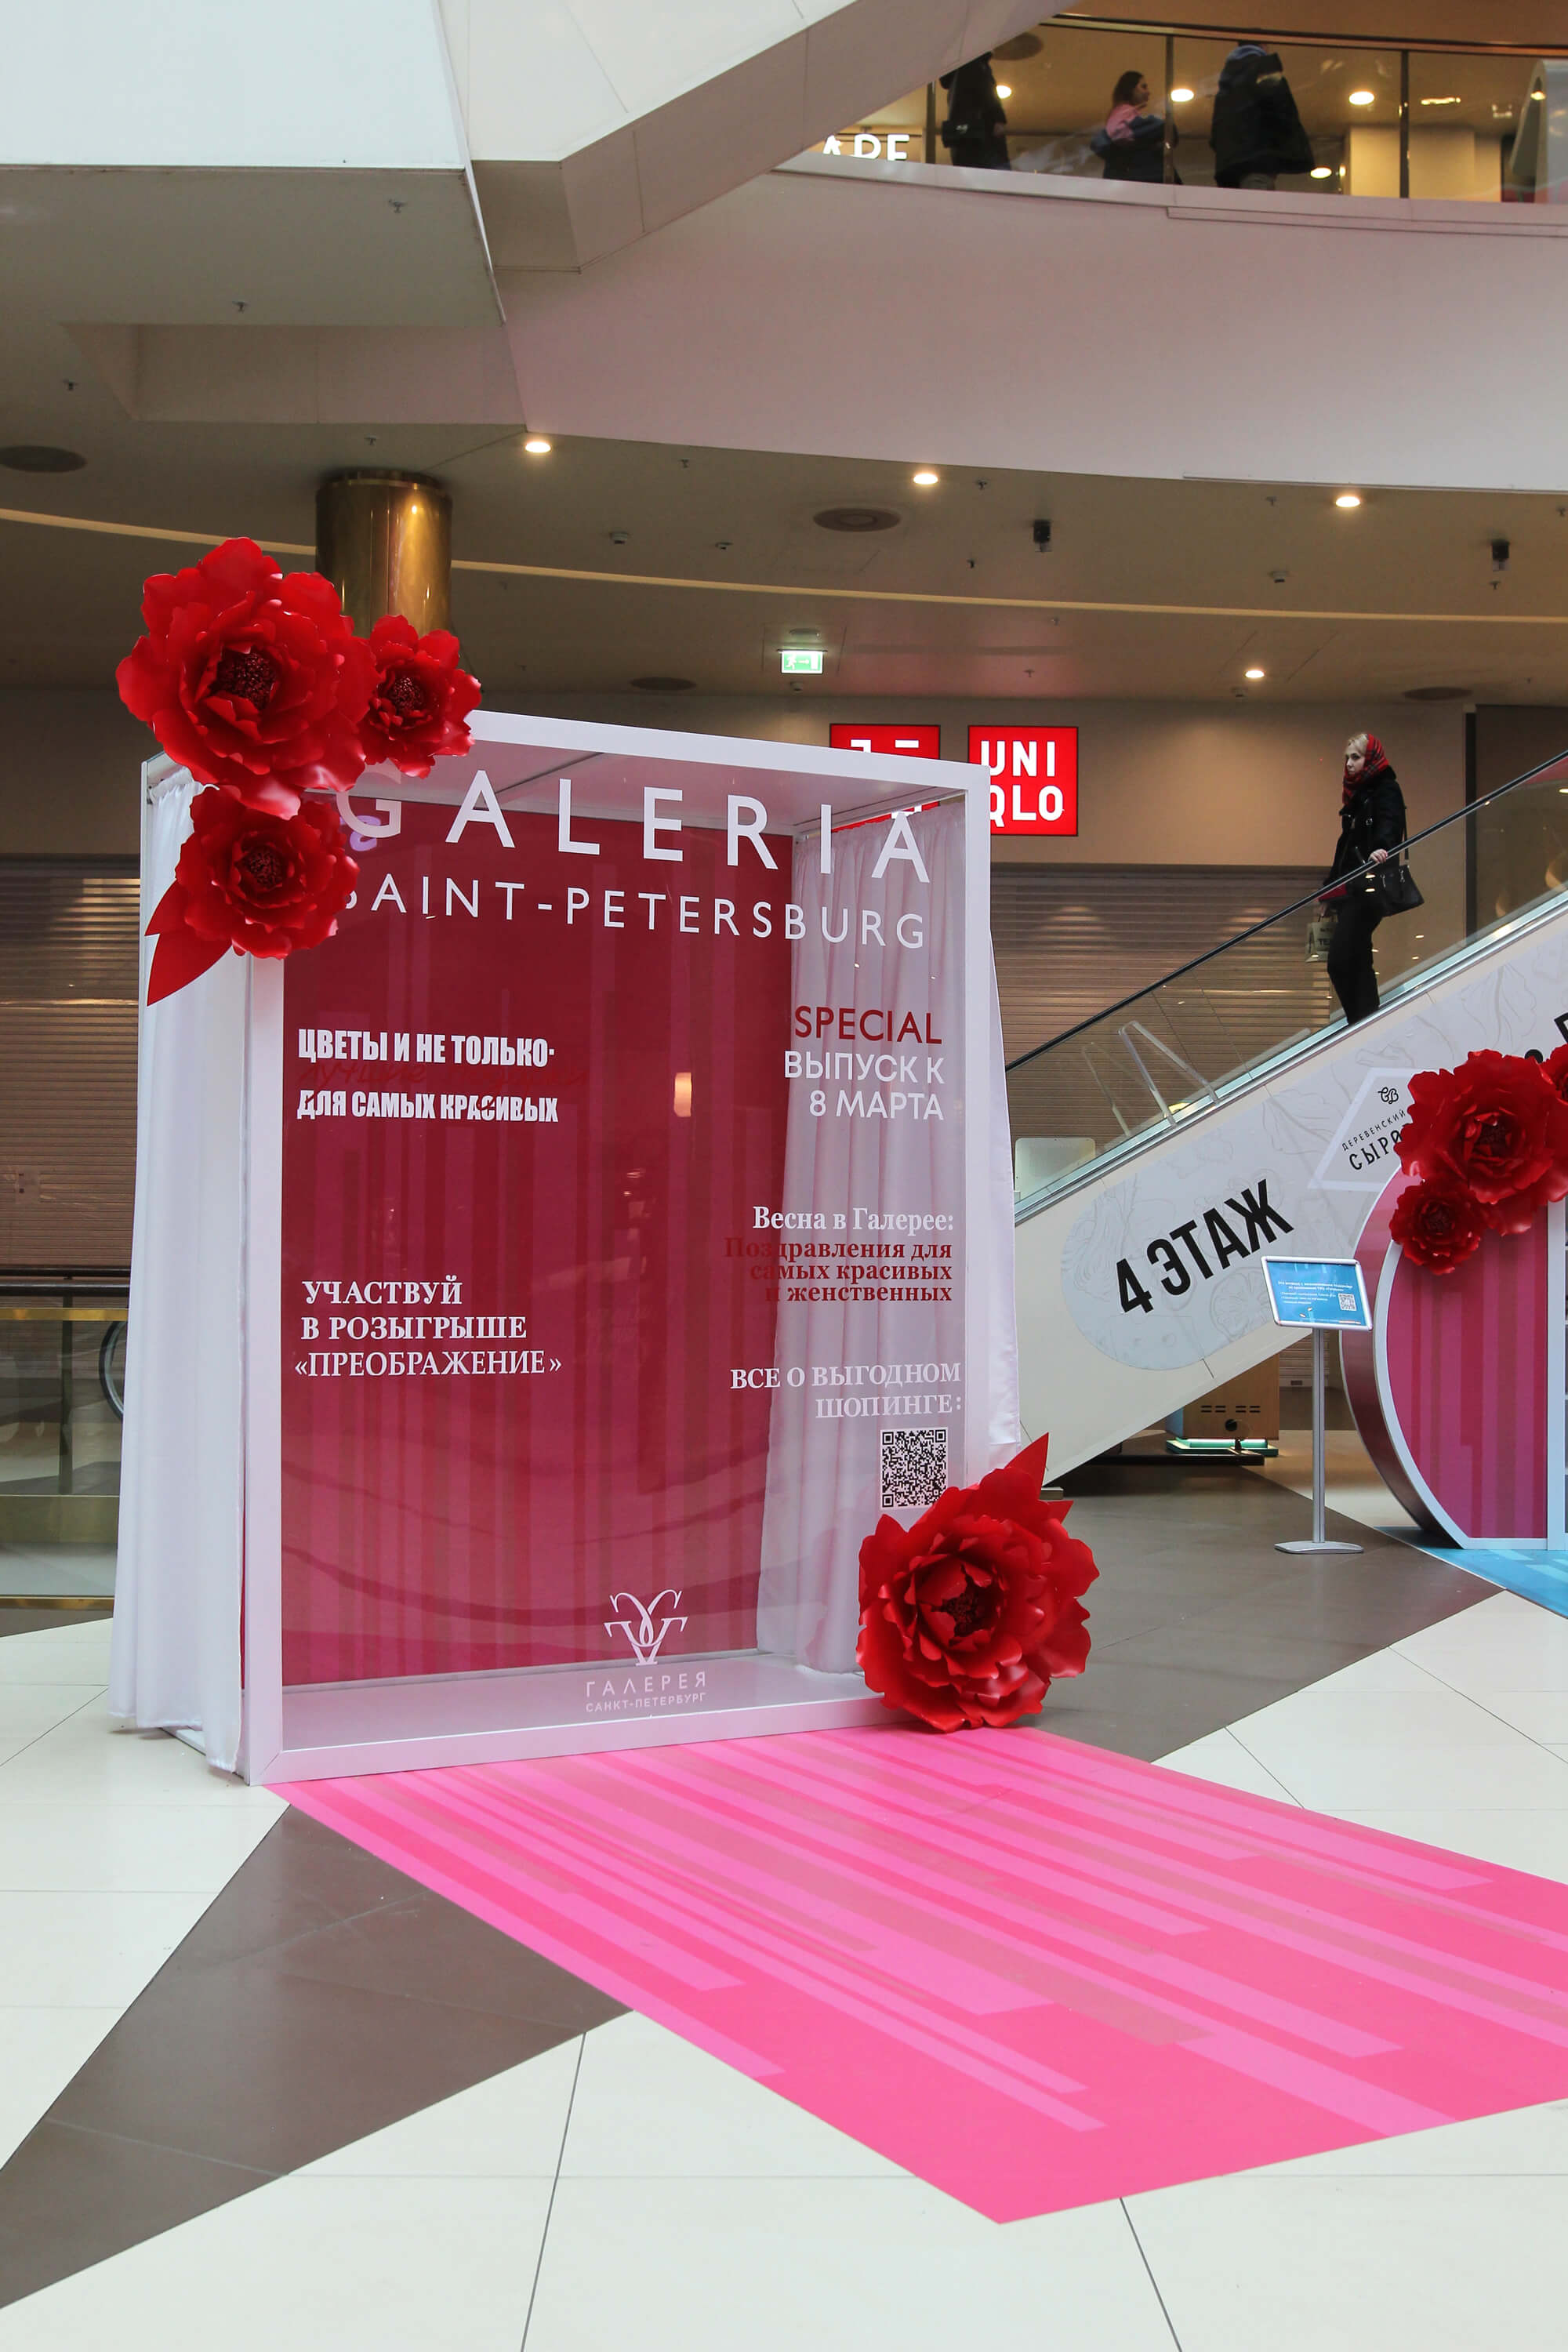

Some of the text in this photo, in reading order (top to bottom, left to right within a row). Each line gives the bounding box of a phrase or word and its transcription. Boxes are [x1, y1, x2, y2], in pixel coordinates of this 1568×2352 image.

[981, 740, 1055, 777] UNI
[336, 760, 930, 884] GALERIA
[345, 873, 924, 949] AINT-PETERSBURG
[794, 1005, 942, 1044] SPECIAL
[298, 1029, 387, 1063] ЦВЕТЫ
[394, 1033, 410, 1062] И
[416, 1033, 445, 1063] НЕ
[784, 1051, 945, 1084] ВЫПУСК К
[297, 1090, 559, 1123] ДЛЯ САМЫХ КРАСИВЫХ
[809, 1090, 945, 1120] 8 МАРТА
[1341, 1109, 1406, 1152] ДЕРЕВЕНСКИЙ
[753, 1206, 954, 1236] Весна в Галерее:
[724, 1237, 953, 1263] Поздравления для
[1116, 1179, 1295, 1315] 4 ЭТАЖ
[750, 1264, 953, 1285] самых красивых
[302, 1275, 463, 1305] УЧАСТВУЙ
[787, 1285, 953, 1301] женственных
[301, 1316, 527, 1340] В РОЗЫГРЫШЕ
[295, 1350, 562, 1377] «ПРЕОБРАЖЕНИЕ»
[730, 1363, 961, 1389] ВСЕ О ВЫГОДНОМ
[815, 1394, 962, 1418] ШОПИНГЕ:
[586, 1671, 706, 1697] ГАЛЕРЕЯ
[586, 1693, 706, 1712] САНКТ-ПЕТЕРБУРГ
